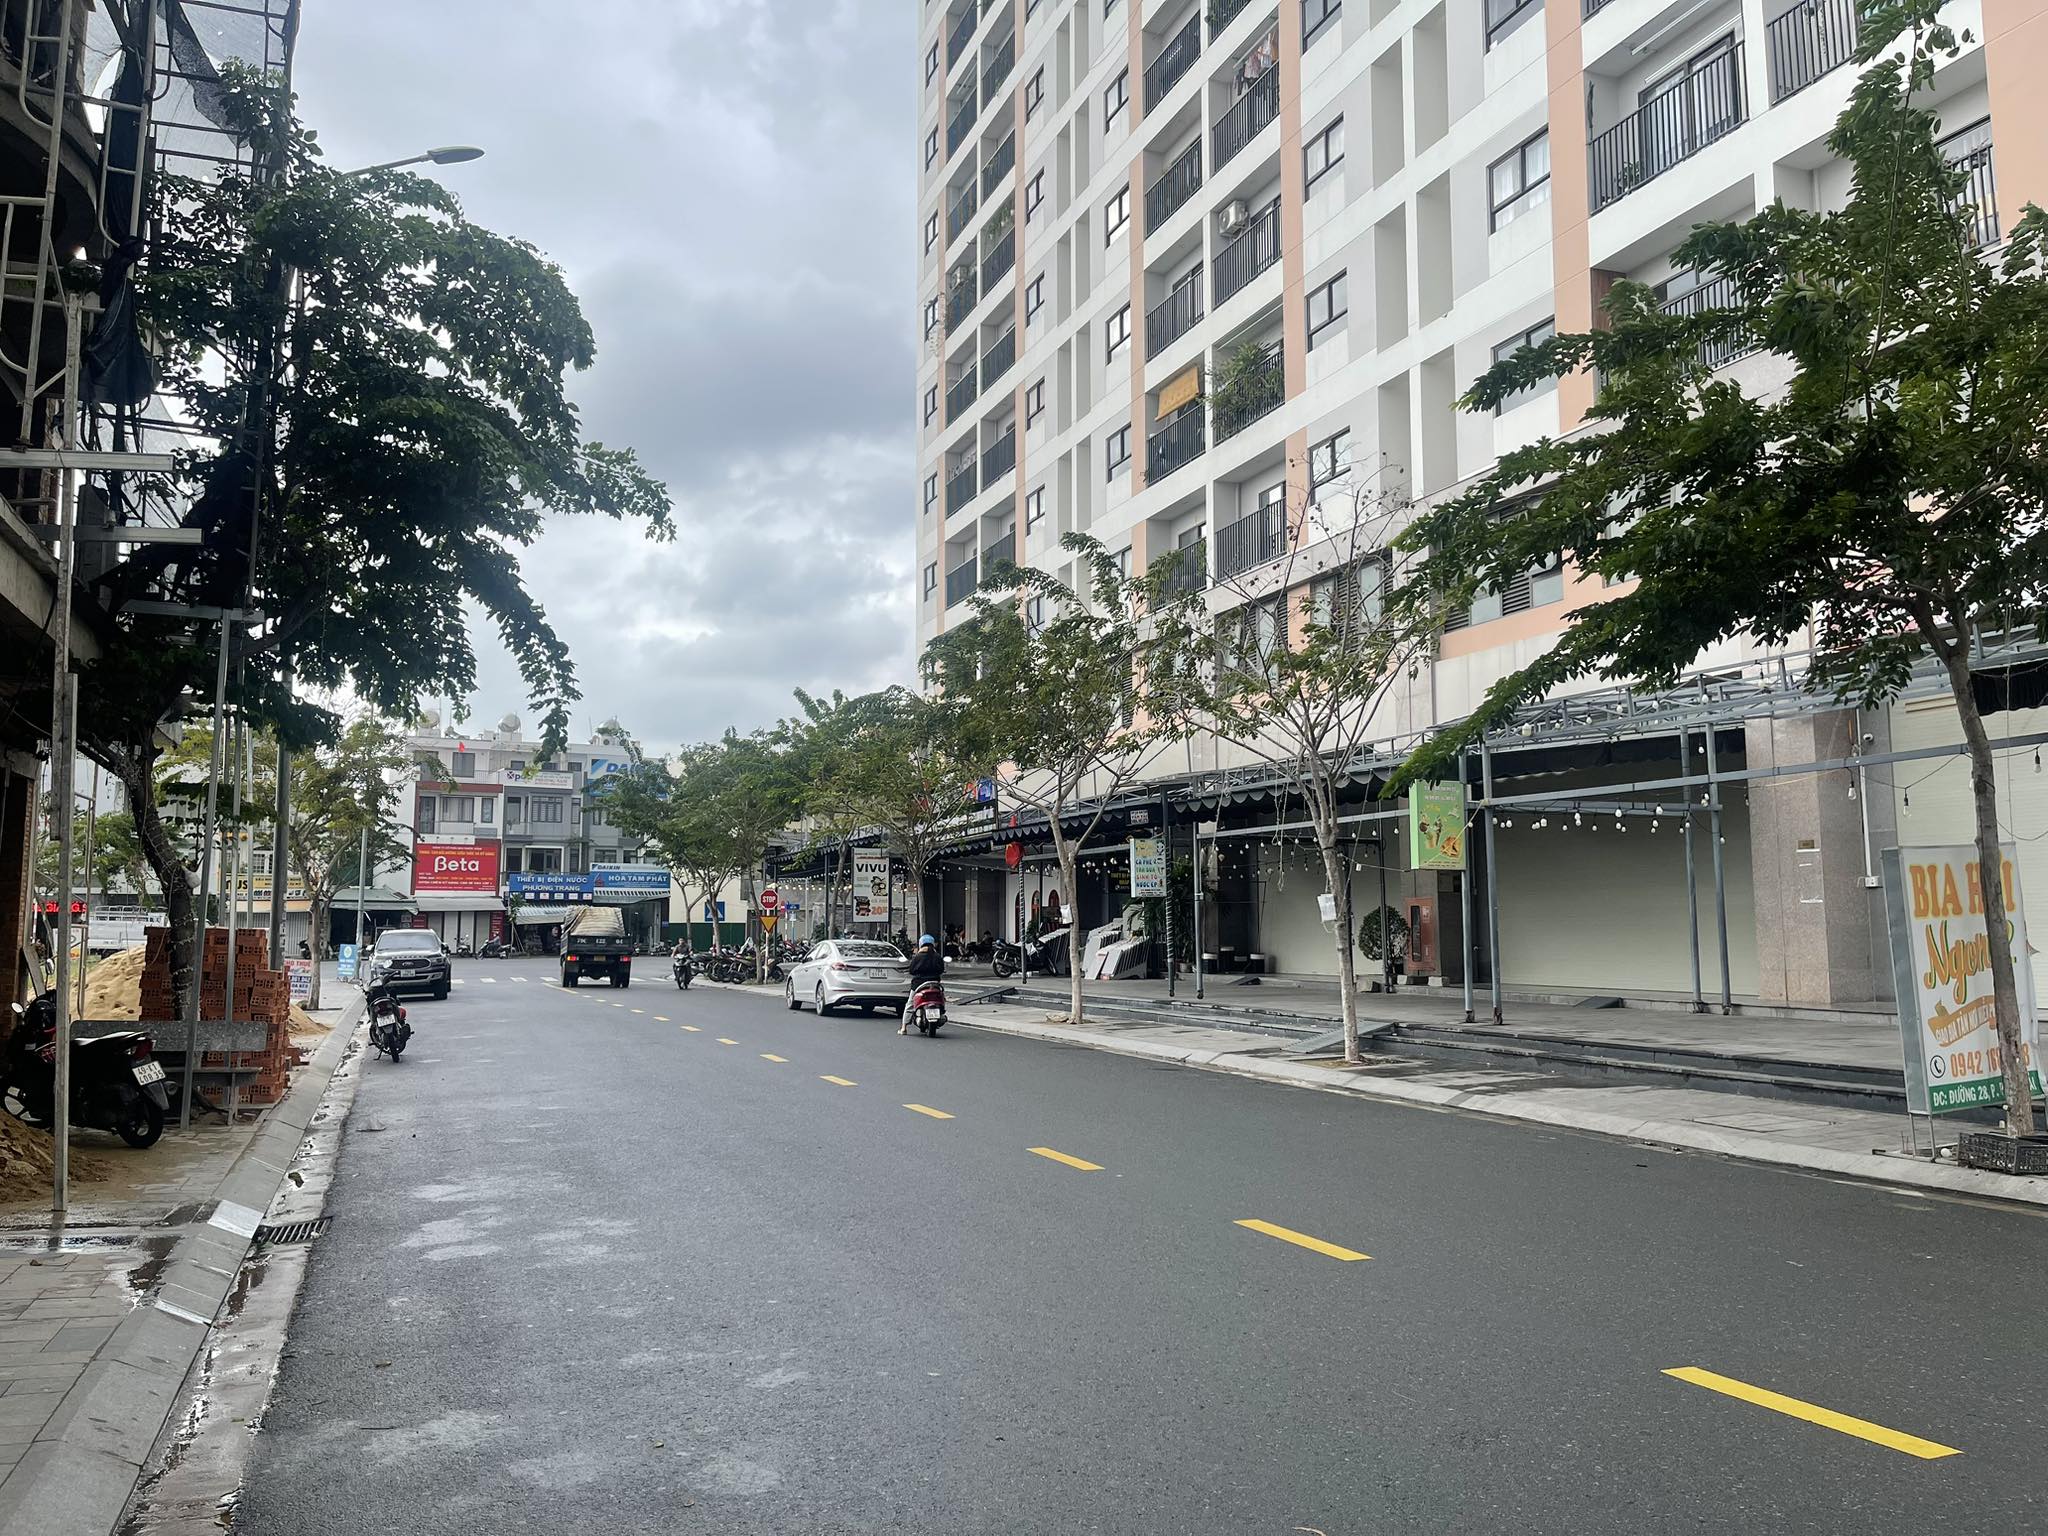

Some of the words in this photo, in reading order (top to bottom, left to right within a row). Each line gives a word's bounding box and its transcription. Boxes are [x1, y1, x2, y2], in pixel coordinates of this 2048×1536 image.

[856, 863, 887, 873] VIVU
[762, 895, 776, 903] STOP
[1909, 862, 1962, 918] BIA
[1965, 859, 2016, 914] HI
[1950, 1050, 1983, 1077] 0942
[1933, 1091, 1948, 1107] ĐC:
[1949, 1082, 1977, 1105] ĐƯỜNG
[1978, 1085, 1991, 1102] 28,
